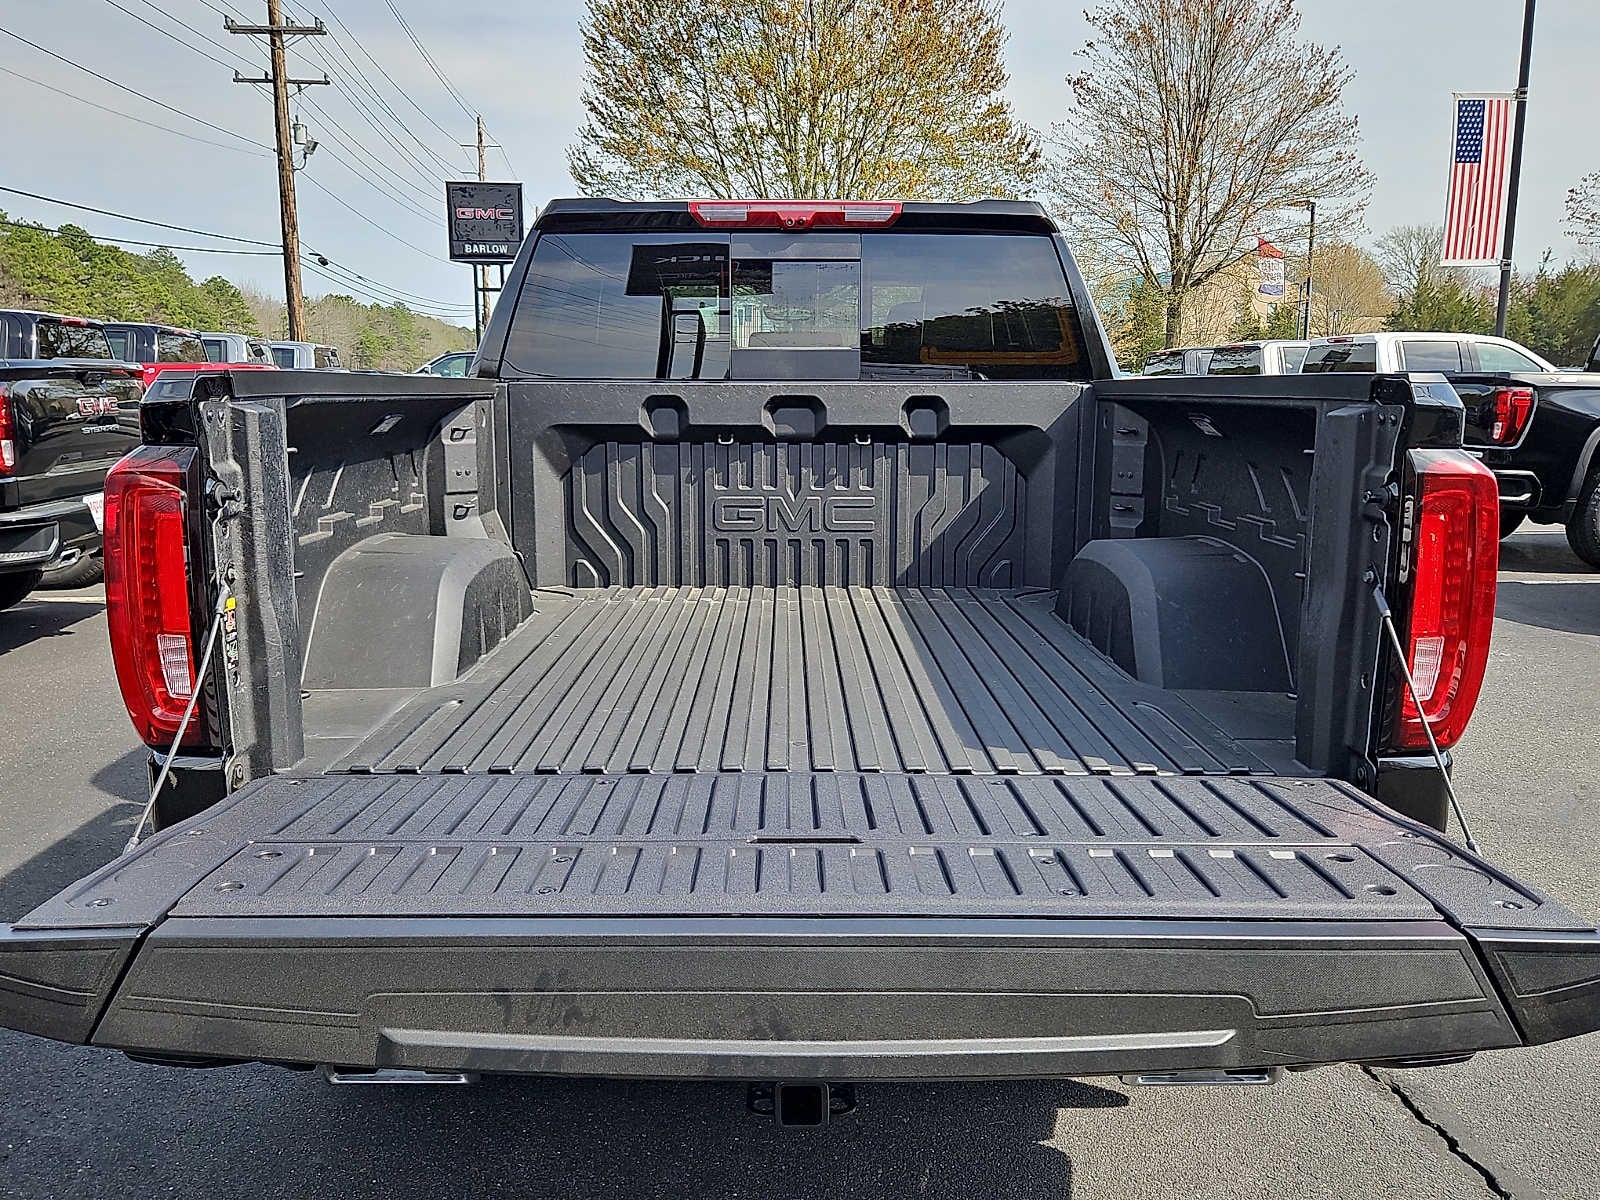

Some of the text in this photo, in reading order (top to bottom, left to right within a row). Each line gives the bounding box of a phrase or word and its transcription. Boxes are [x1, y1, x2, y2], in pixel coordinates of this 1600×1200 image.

[456, 207, 514, 220] GMC
[464, 243, 509, 254] BARLOW
[76, 396, 120, 416] GMC
[81, 424, 120, 434] SIERRA
[713, 496, 876, 533] GMC
